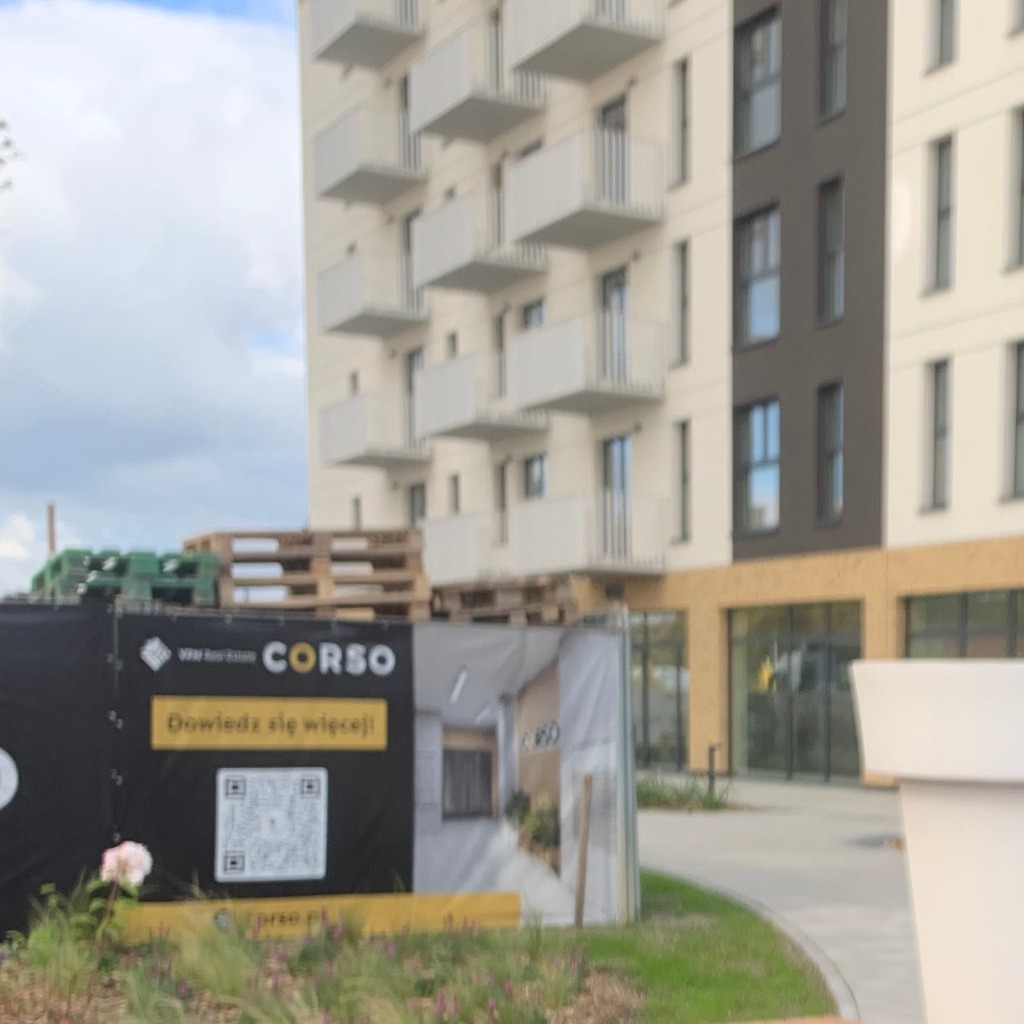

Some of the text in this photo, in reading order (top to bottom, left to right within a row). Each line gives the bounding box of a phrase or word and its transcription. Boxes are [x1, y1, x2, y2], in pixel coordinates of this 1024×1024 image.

[262, 640, 396, 677] CORSO
[168, 712, 375, 739] Dowiedz się więcej!
